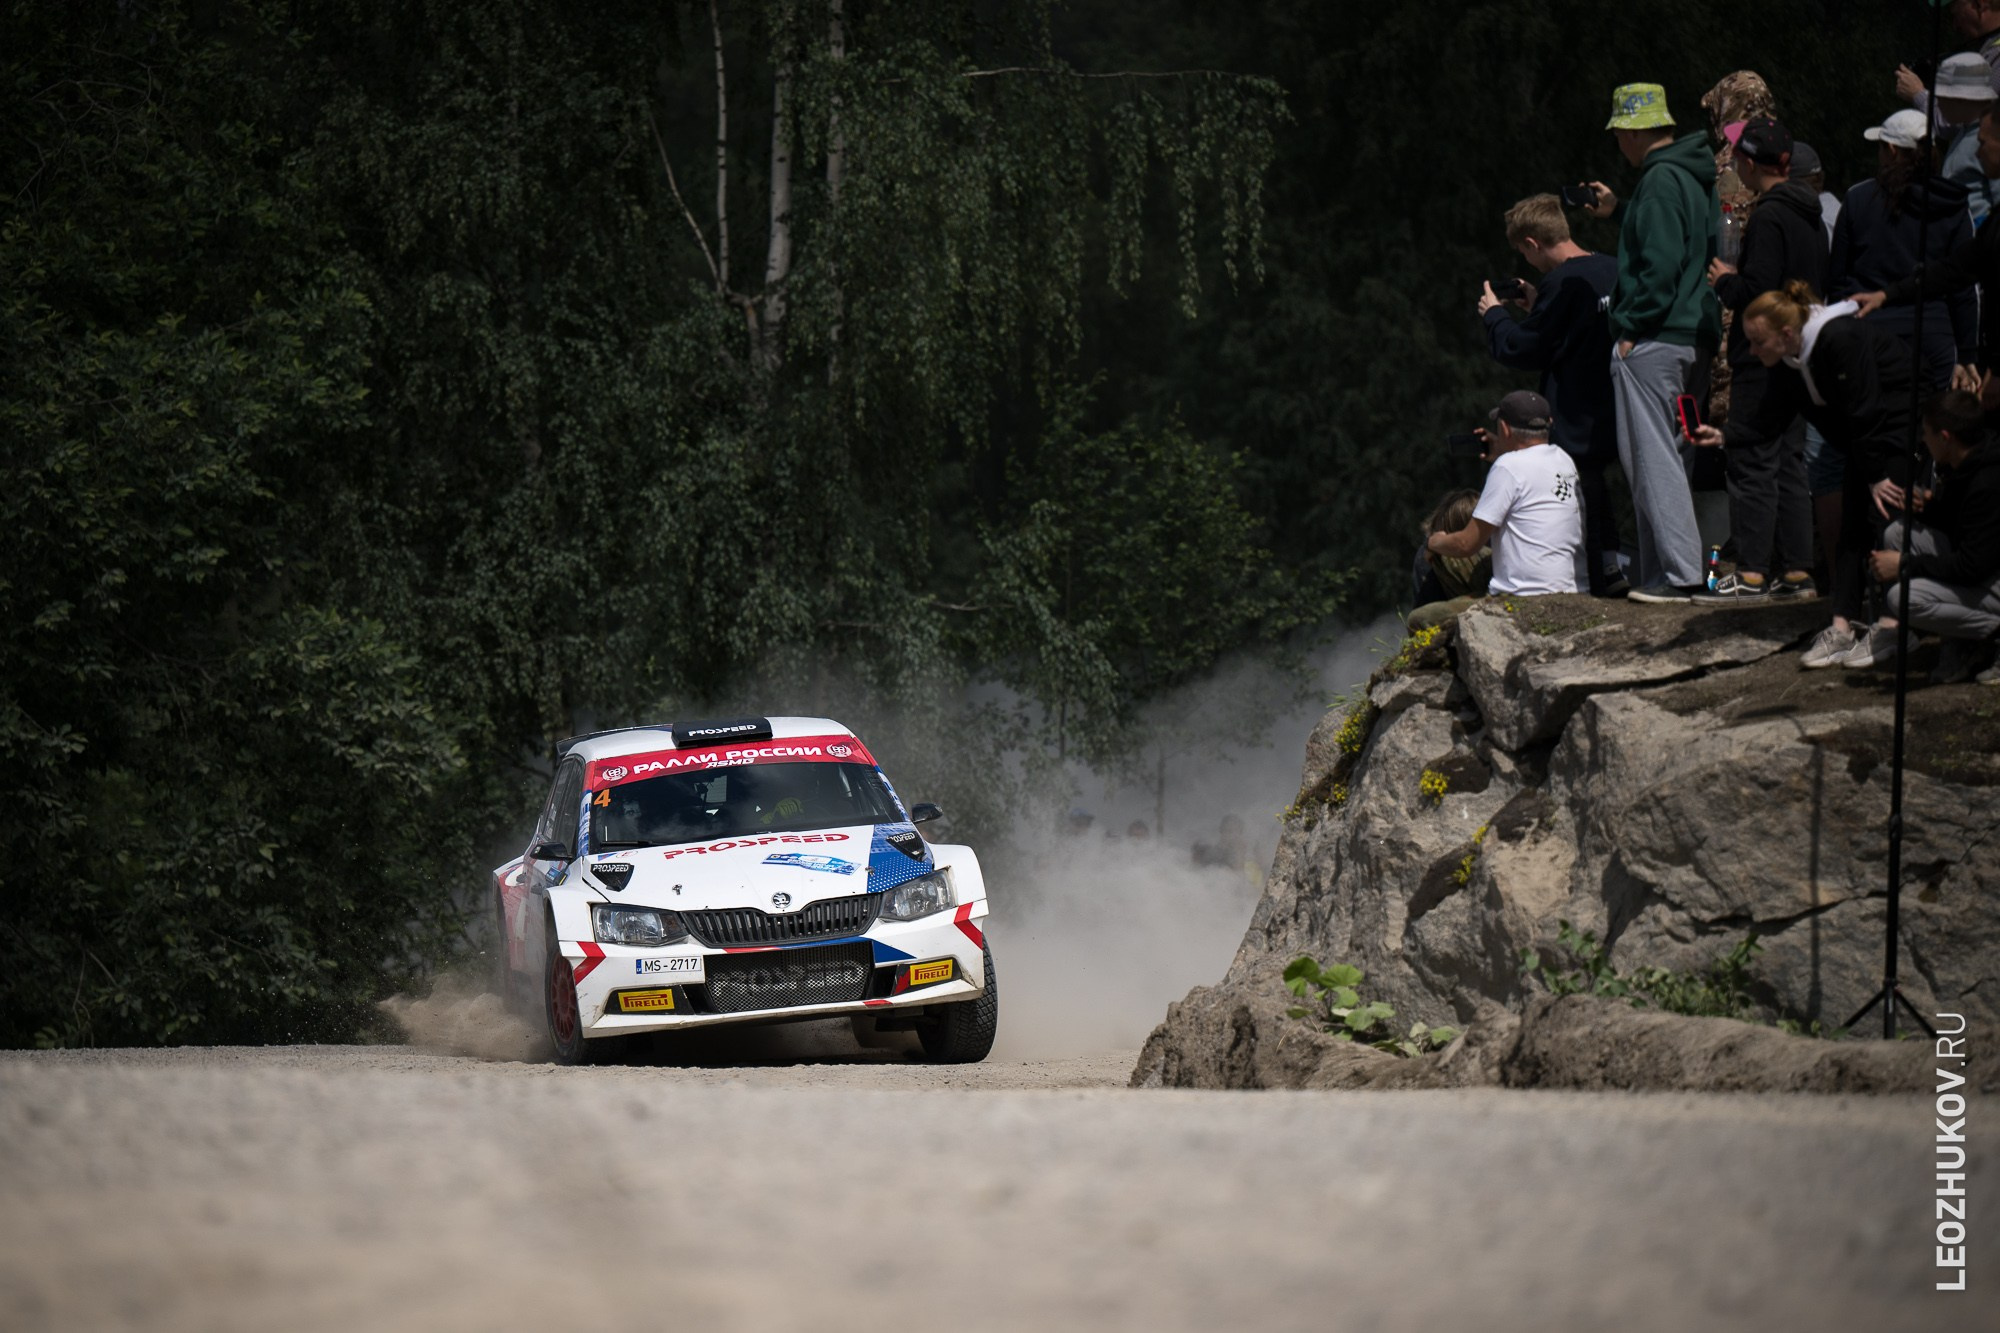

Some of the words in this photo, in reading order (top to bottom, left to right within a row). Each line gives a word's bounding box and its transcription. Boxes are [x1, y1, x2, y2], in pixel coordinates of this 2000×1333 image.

[688, 724, 757, 737] PROSPEED
[633, 752, 716, 775] РАЛЛИ
[726, 746, 822, 760] РОССИИ
[593, 788, 612, 808] 4
[663, 833, 850, 860] PROSPEED
[593, 864, 630, 873] PROSPEED
[914, 964, 949, 981] PIRELLI
[623, 993, 668, 1008] PIRELLI
